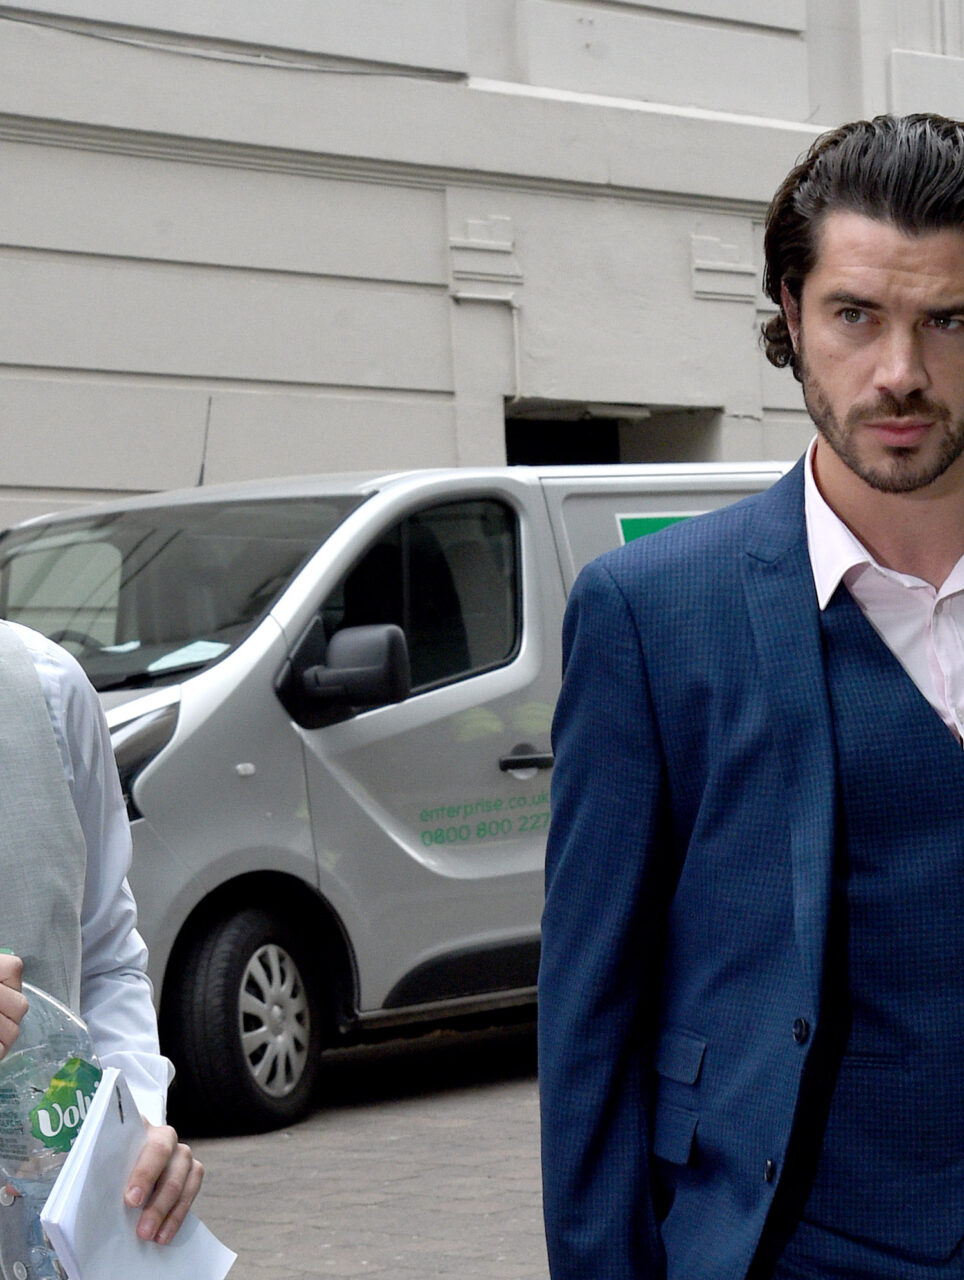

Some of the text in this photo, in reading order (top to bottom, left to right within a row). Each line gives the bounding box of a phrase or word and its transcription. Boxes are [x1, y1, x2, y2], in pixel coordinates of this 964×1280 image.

[420, 790, 549, 822] enterprise.co.uk
[421, 811, 550, 847] 0800 800 227
